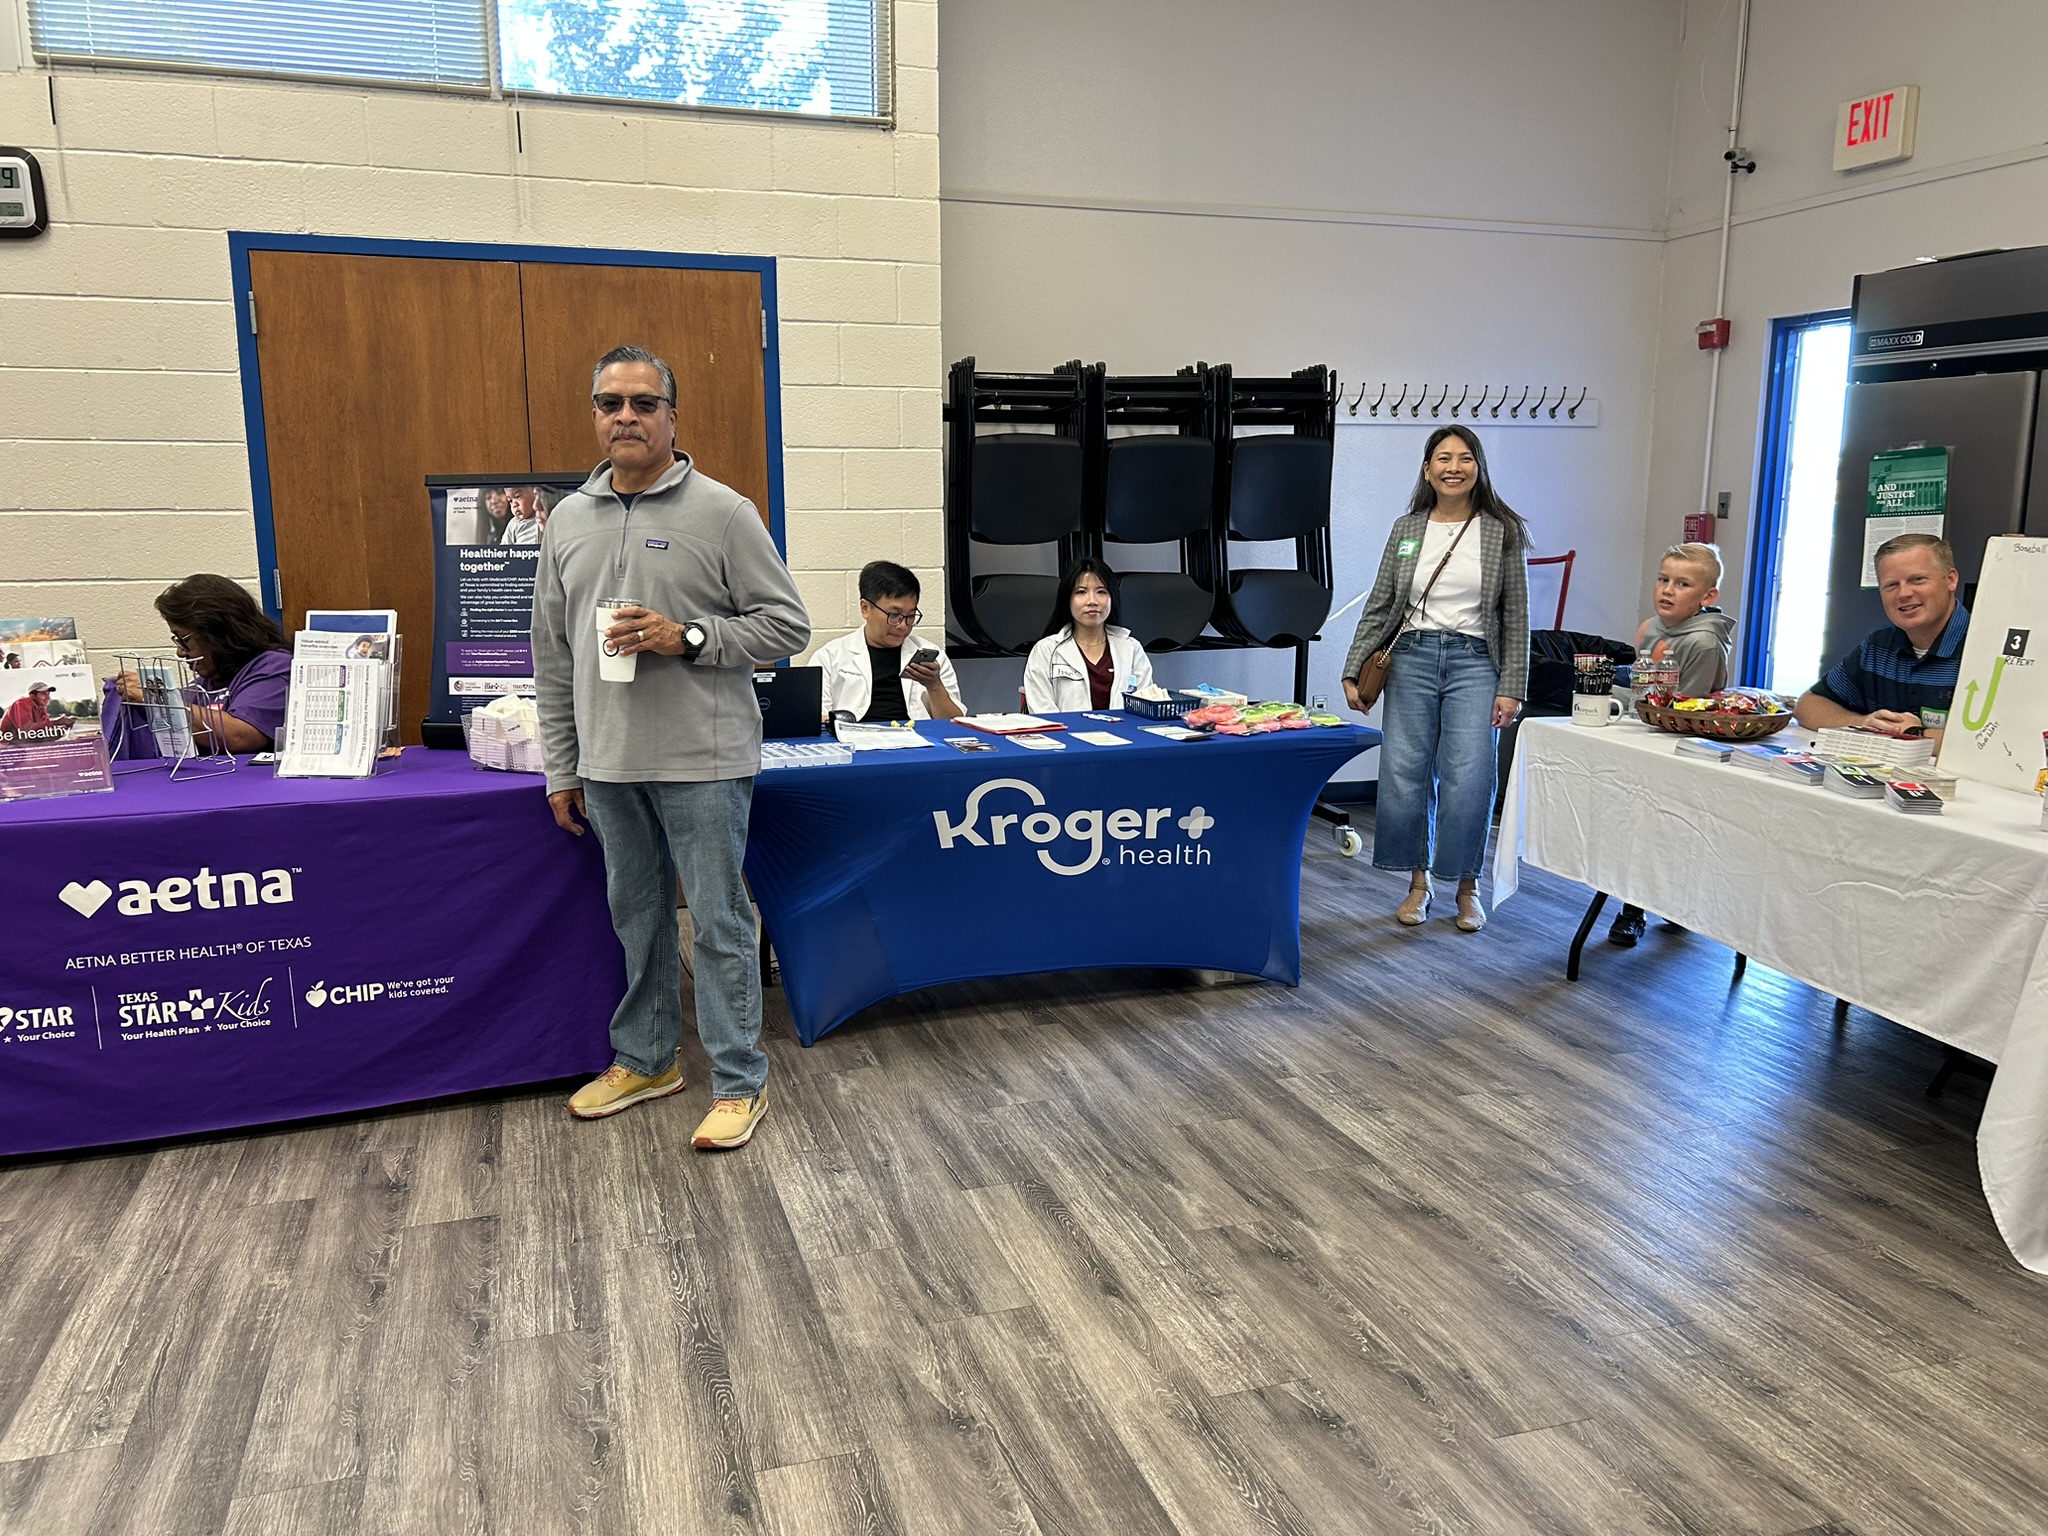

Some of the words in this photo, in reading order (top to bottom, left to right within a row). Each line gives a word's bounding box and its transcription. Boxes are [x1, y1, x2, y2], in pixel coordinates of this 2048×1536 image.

[1846, 93, 1895, 147] EXIT
[1877, 336, 1899, 347] MAXX
[1900, 333, 1921, 344] COLD
[1876, 489, 1916, 500] JUSTICE
[1877, 483, 1897, 492] AND
[1886, 498, 1904, 507] ALL
[460, 549, 508, 559] Healthier
[510, 549, 541, 560] happe
[2010, 635, 2022, 650] 3
[2004, 655, 2036, 667] REPENT
[1923, 712, 1941, 725] David
[17, 725, 72, 740] healthy
[932, 778, 1172, 876] Kroger
[1119, 843, 1211, 865] health
[65, 954, 116, 970] AETNA
[120, 949, 175, 965] BETTER
[246, 941, 266, 954] OF
[268, 936, 312, 950] TEXAS
[387, 980, 414, 990] We've
[416, 978, 432, 988] got
[433, 976, 455, 986] your
[118, 991, 159, 1004] TEXAS
[329, 982, 385, 1005] CHIP
[388, 989, 408, 999] kids
[410, 985, 449, 997] covered.
[118, 1001, 178, 1027] STAR
[213, 977, 273, 1021] Kids
[15, 1006, 75, 1030] STAR
[17, 1033, 41, 1042] Your
[42, 1030, 76, 1040] Choice
[121, 1032, 144, 1041] Your
[145, 1028, 177, 1039] Health
[178, 1026, 200, 1035] Plan
[217, 1022, 239, 1031] Your
[240, 1018, 271, 1029] Choice
